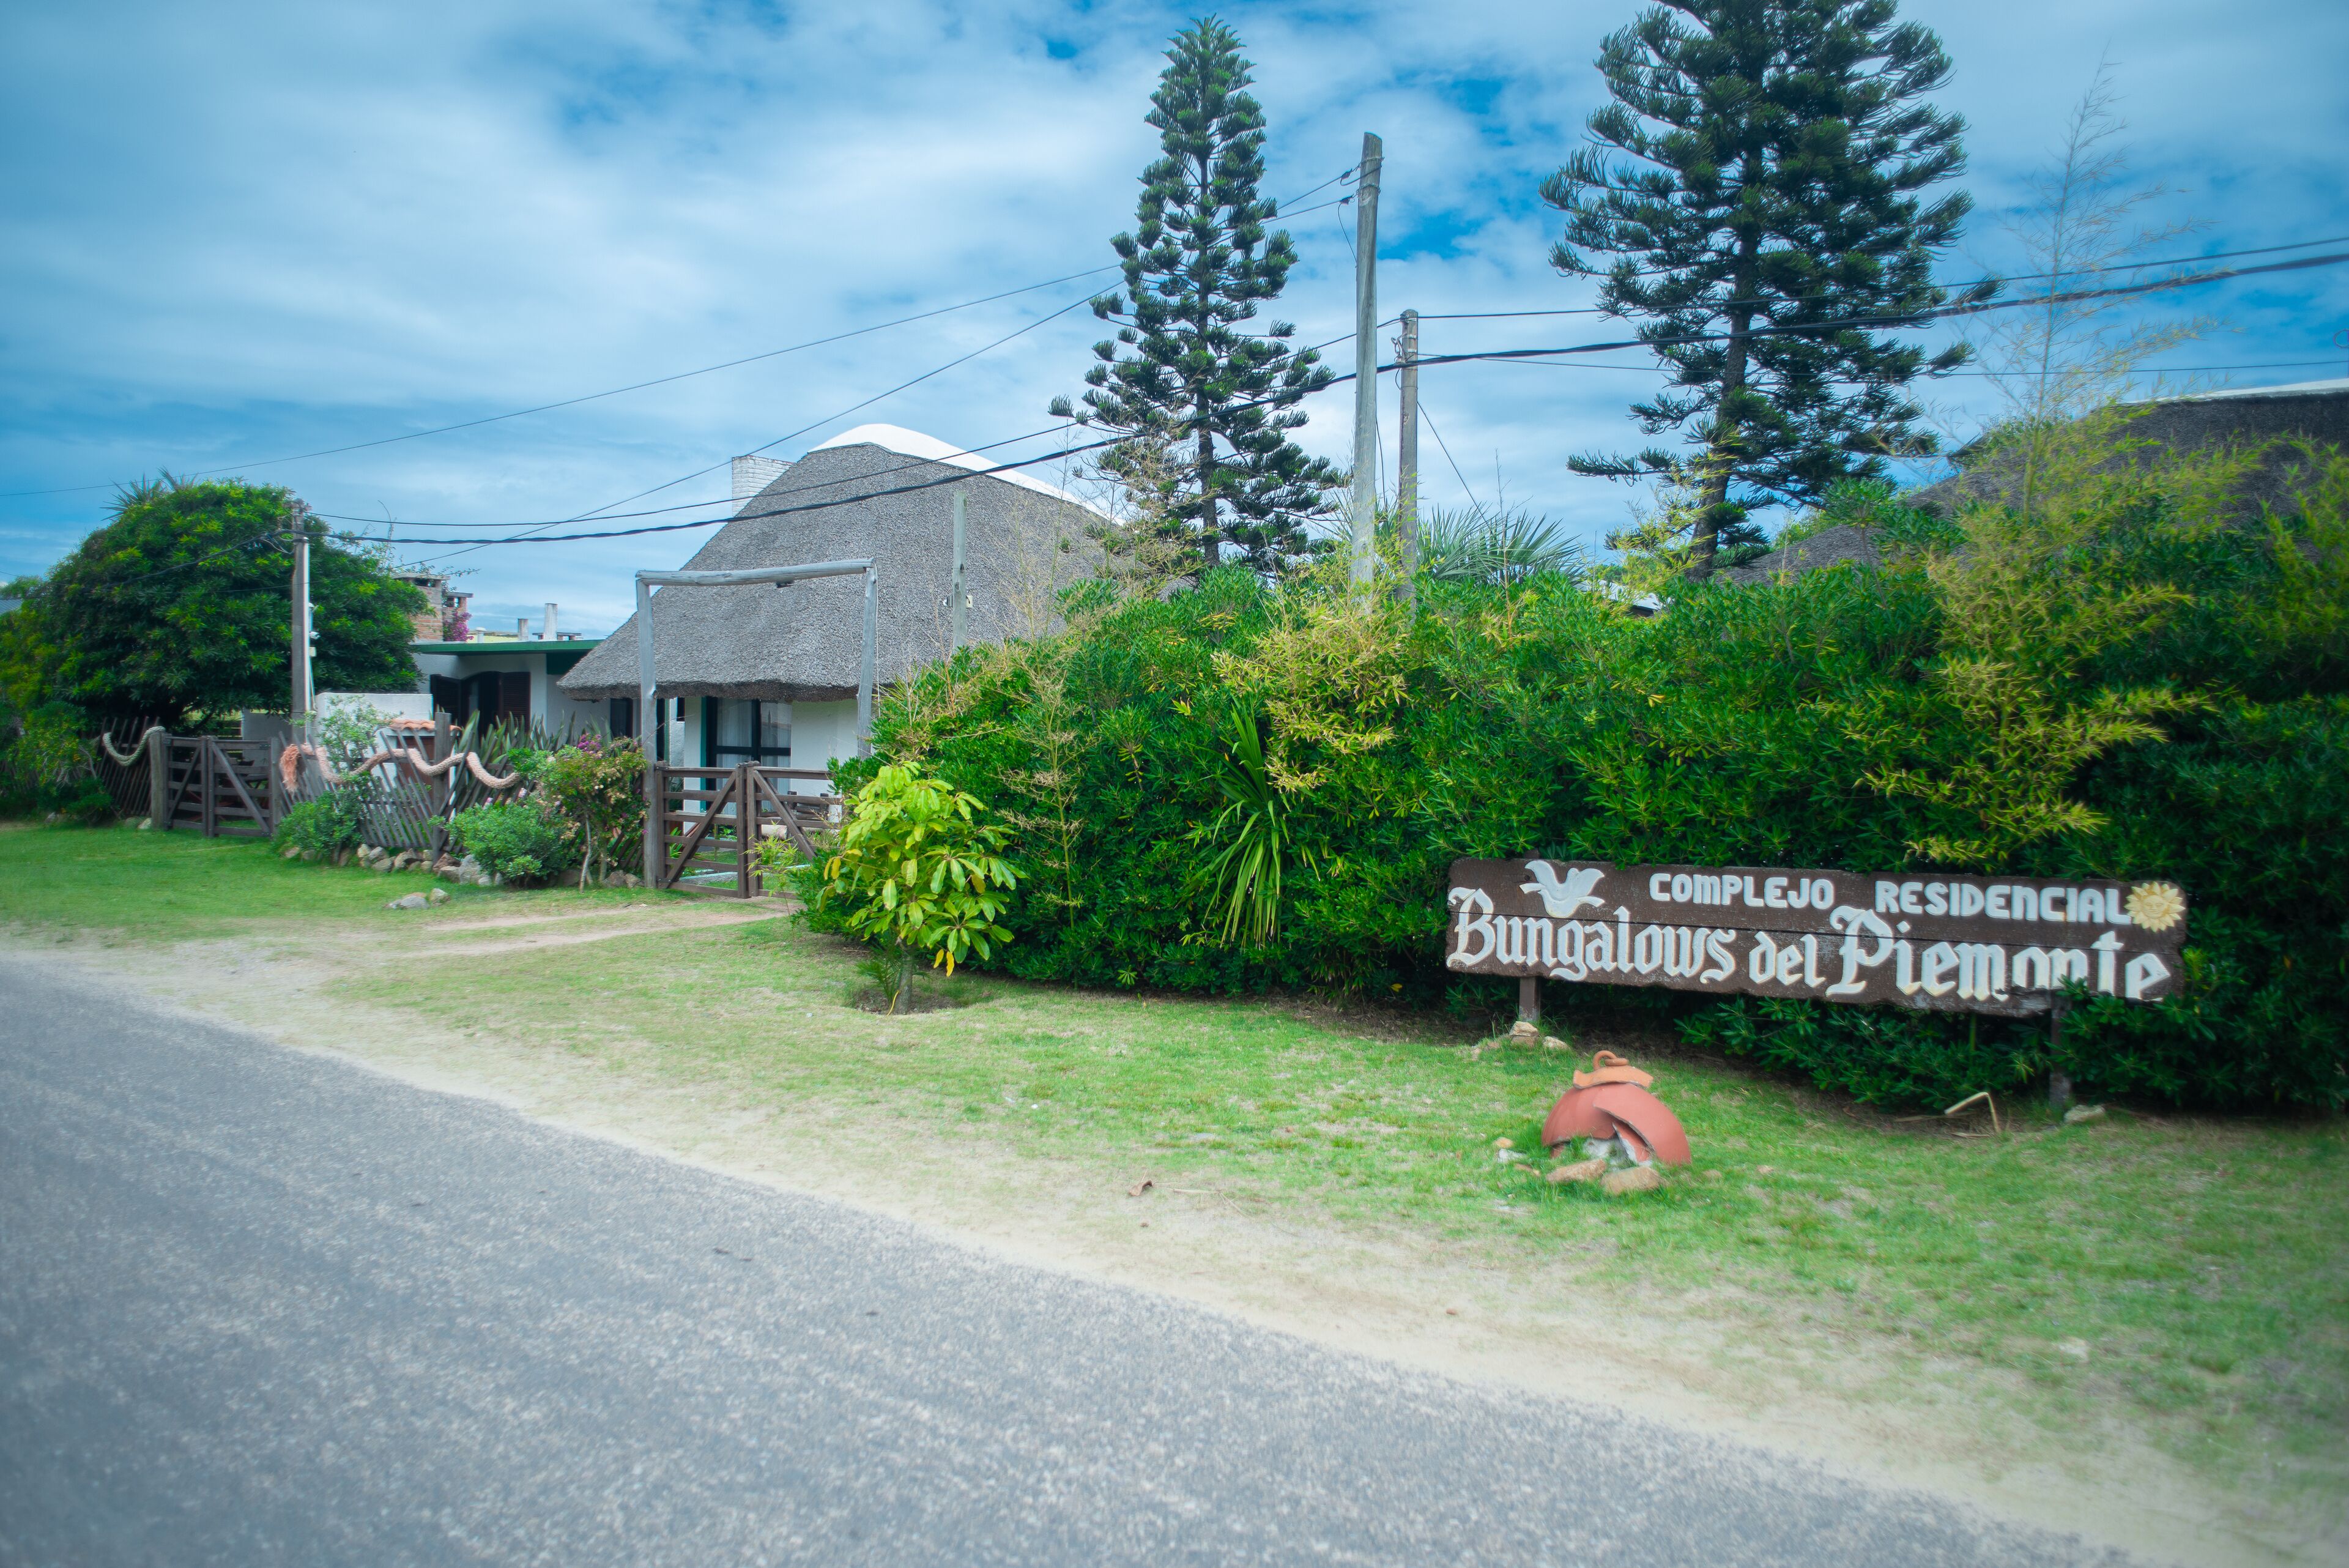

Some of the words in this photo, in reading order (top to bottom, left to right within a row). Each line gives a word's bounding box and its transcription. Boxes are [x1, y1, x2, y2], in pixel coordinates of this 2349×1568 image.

[1650, 873, 1834, 910] COMPLEJO
[1875, 880, 2131, 925] RESIDENCIAL
[1446, 886, 1736, 984] Bungalows
[1749, 931, 1826, 988] del
[1825, 905, 2171, 1002] Piemonte
